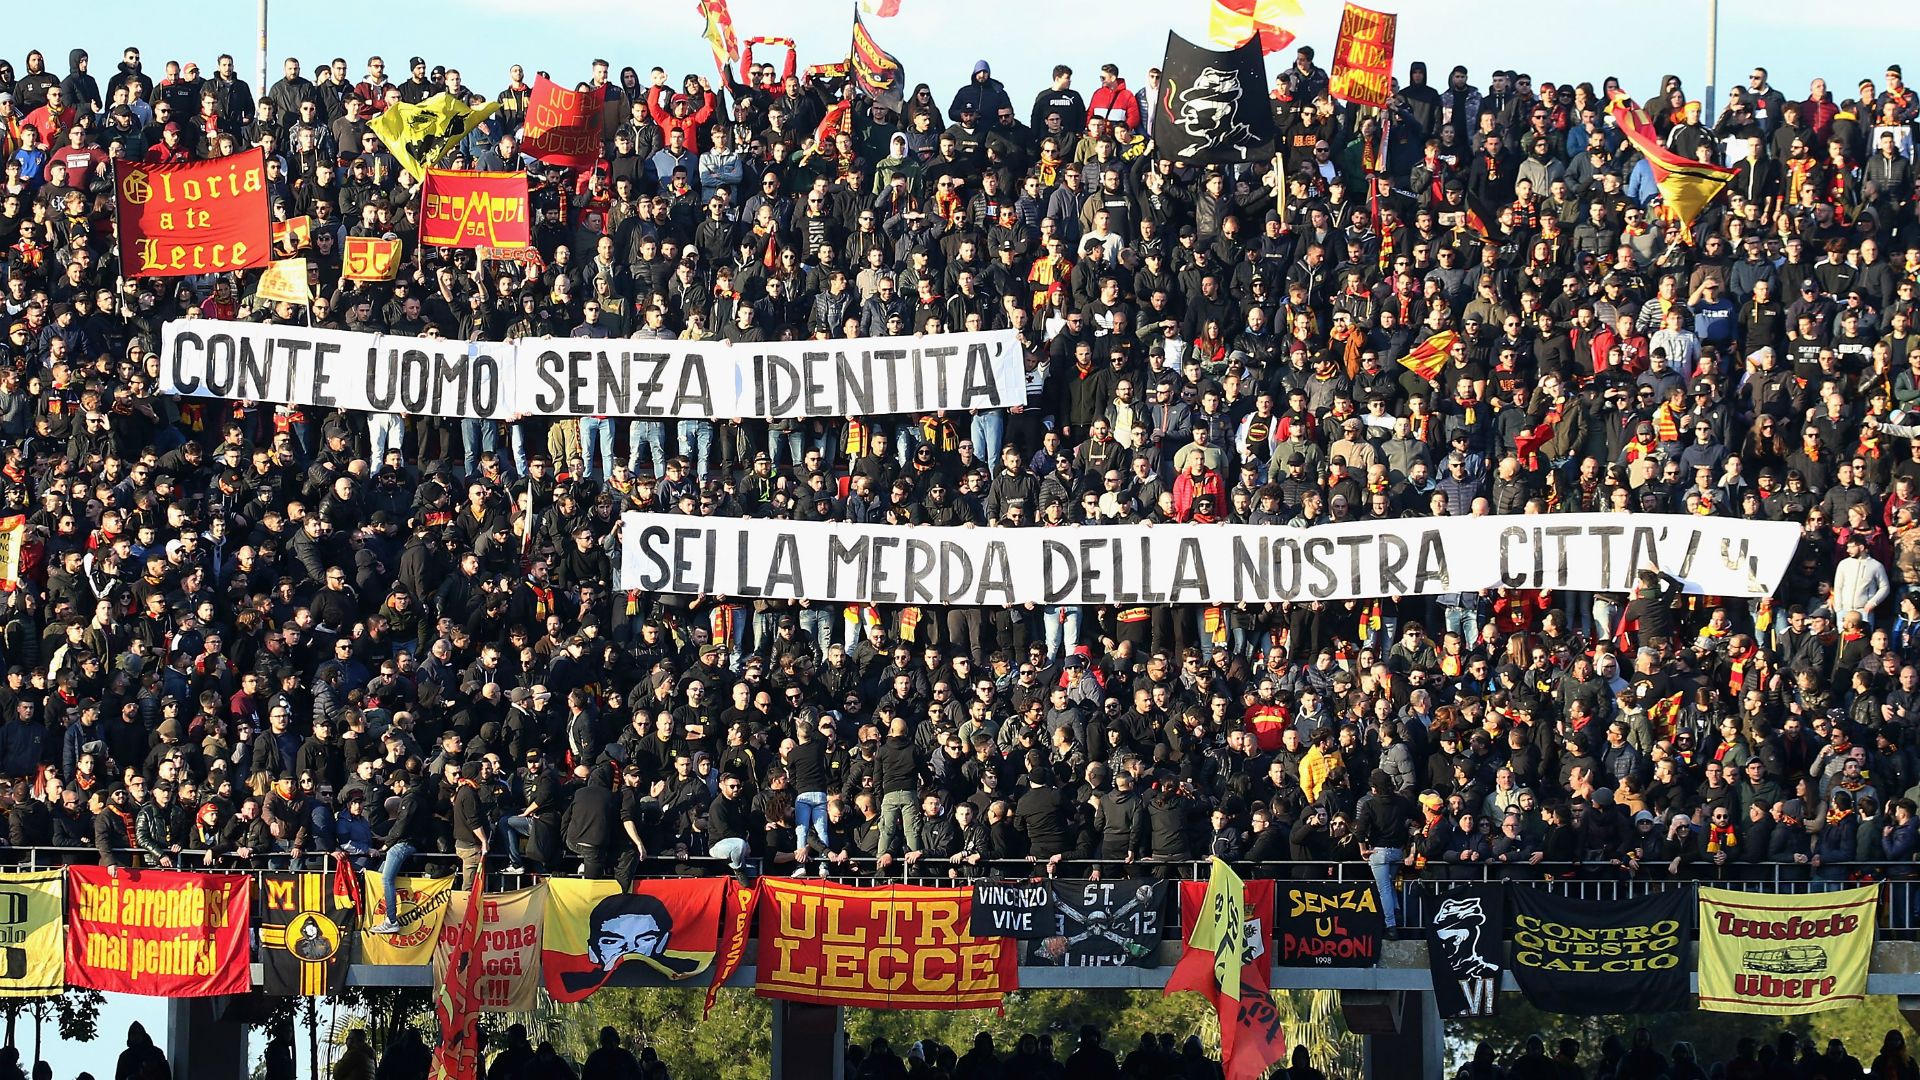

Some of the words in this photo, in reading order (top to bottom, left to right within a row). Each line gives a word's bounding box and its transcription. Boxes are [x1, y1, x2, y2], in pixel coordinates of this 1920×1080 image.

[1367, 45, 1387, 68] DA
[123, 164, 262, 204] Gloria
[160, 212, 175, 230] a
[186, 208, 211, 228] te
[136, 238, 247, 271] Lecce
[172, 330, 340, 407] CONTE
[366, 346, 499, 418] UOMO
[536, 350, 714, 416] SENZA
[754, 341, 1002, 417] IDENTITA'
[640, 525, 717, 593] SEI
[738, 530, 805, 599] LA
[827, 534, 1015, 605] MERDA
[1043, 536, 1210, 603] DELLA
[1233, 529, 1450, 601] NOSTRA
[80, 879, 119, 926] mai
[122, 882, 231, 928] arrendersi
[978, 886, 1048, 908] VINCENZO
[1083, 884, 1114, 906] ST.
[1290, 888, 1377, 917] SENZA
[992, 910, 1033, 931] VIVE
[1128, 911, 1157, 935] 12
[1316, 916, 1347, 937] UL
[1516, 914, 1679, 941] CONTRO
[1715, 911, 1858, 947] Trasferte
[389, 925, 432, 947] LECCE
[1284, 934, 1373, 960] PADRONI
[1514, 932, 1679, 957] QUESTO
[87, 930, 129, 972] mai
[131, 933, 217, 980] pentirsi
[772, 938, 1000, 991] LECCE
[1315, 957, 1332, 965] 1998
[1516, 953, 1679, 972] CALCIO
